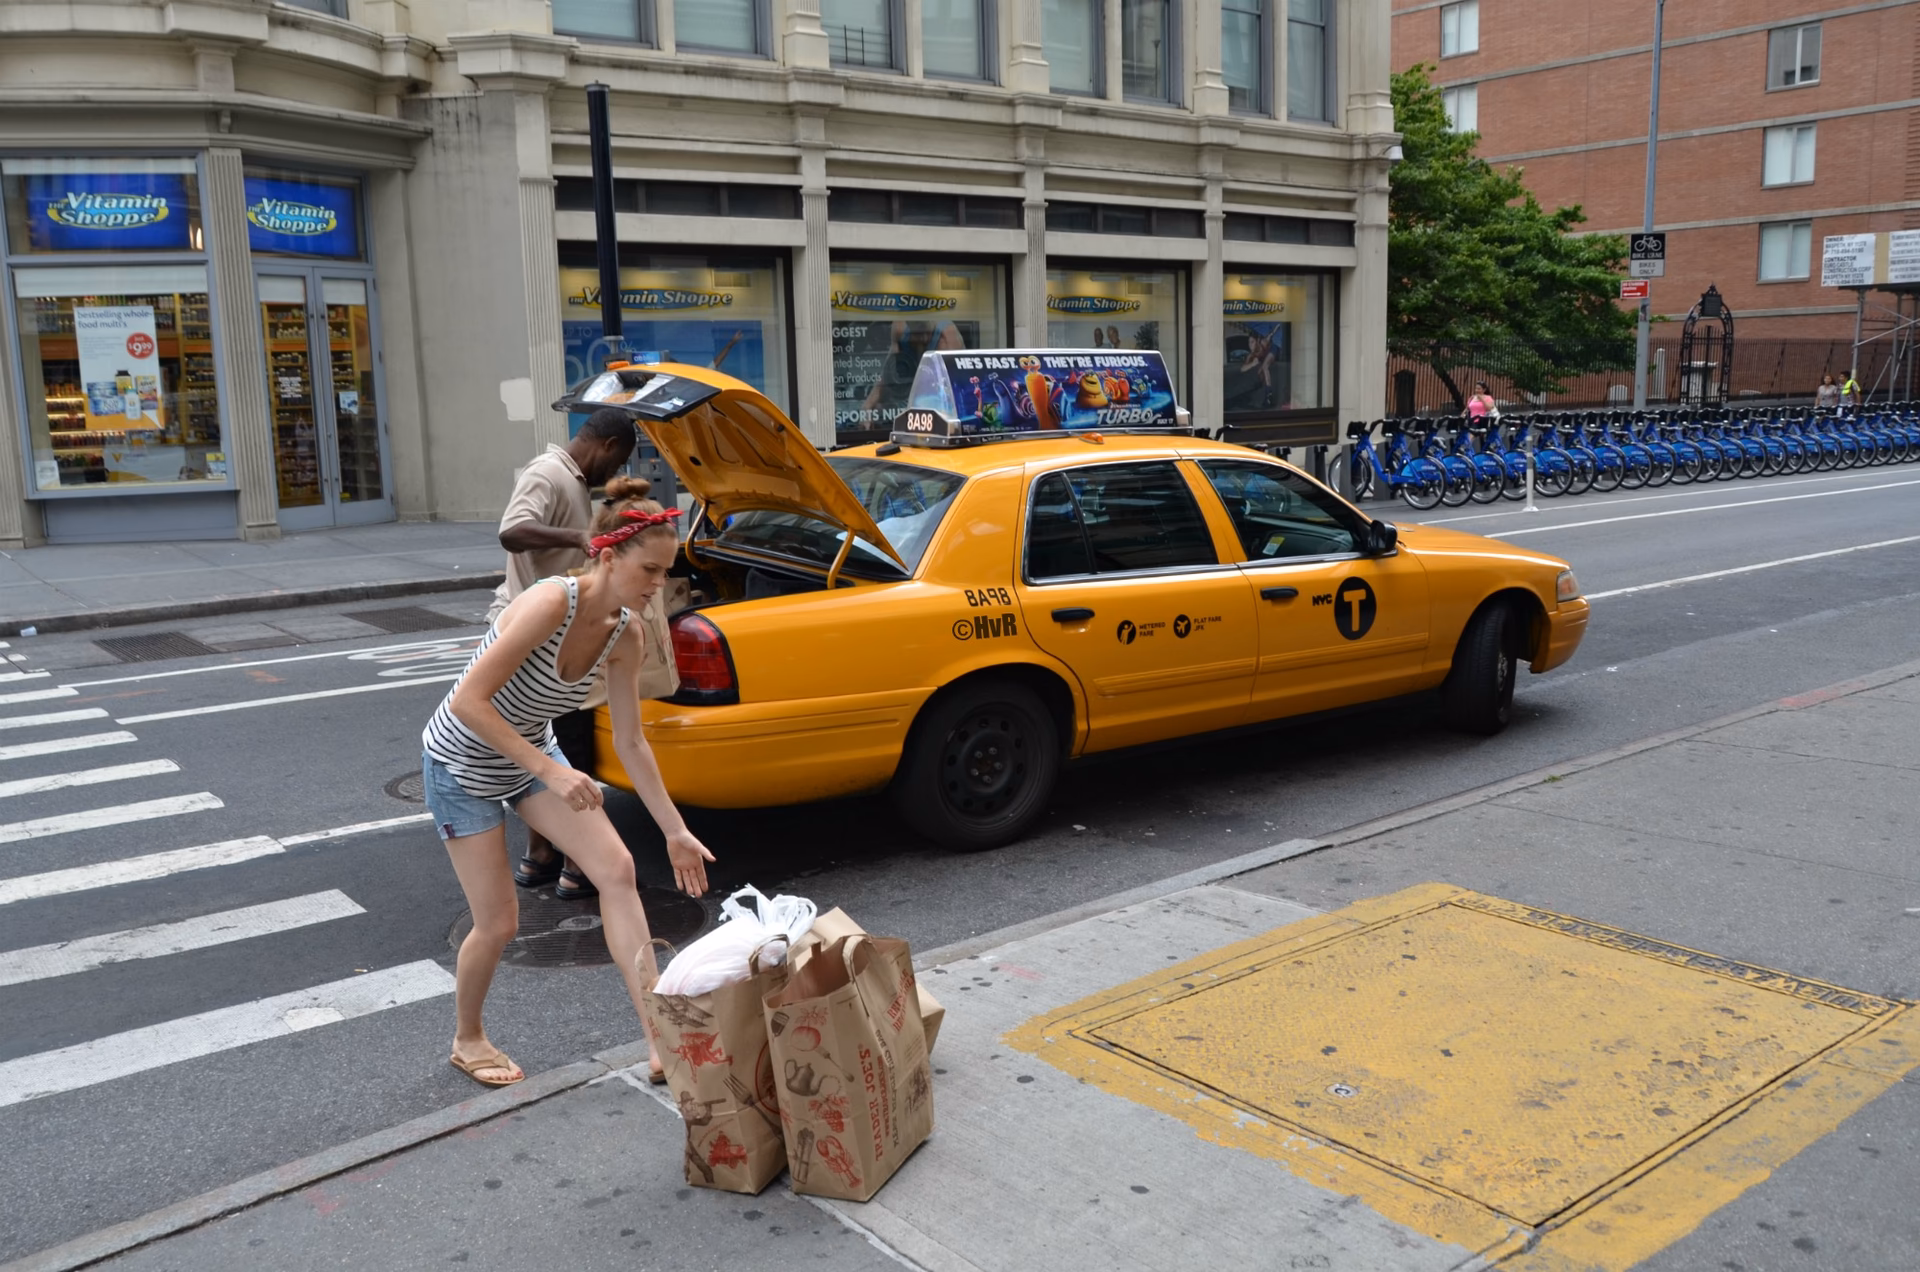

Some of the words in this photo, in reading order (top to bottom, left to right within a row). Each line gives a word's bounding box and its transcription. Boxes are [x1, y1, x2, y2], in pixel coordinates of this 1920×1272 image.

[67, 192, 167, 209] Vitamin
[262, 197, 336, 219] Vitamin
[61, 210, 156, 226] Shoppe
[257, 214, 327, 233] Shoppe
[583, 287, 658, 304] Vmin
[661, 290, 732, 307] Shoppe
[835, 291, 897, 306] Vitamin
[898, 294, 957, 310] Shoppe
[1092, 297, 1141, 312] Shoppe
[1244, 300, 1285, 314] Shoppe
[77, 310, 122, 320] bestselling
[78, 320, 98, 328] food
[832, 326, 868, 338] GGEST
[845, 340, 855, 353] of
[854, 356, 882, 370] Sports
[955, 357, 983, 370] HE'S
[985, 356, 1018, 370] FAST.
[1043, 356, 1094, 369] THEY'RE
[1095, 355, 1148, 368] FURIOUS.
[846, 373, 882, 384] Products
[835, 409, 880, 423] SPORTS
[907, 412, 933, 431] 8A98
[1096, 407, 1160, 425] TURBO
[1312, 593, 1333, 606] NYC
[1343, 588, 1366, 632] T
[1139, 621, 1166, 630] METERED
[1193, 617, 1207, 625] FLAT
[869, 1097, 883, 1162] TRADER
